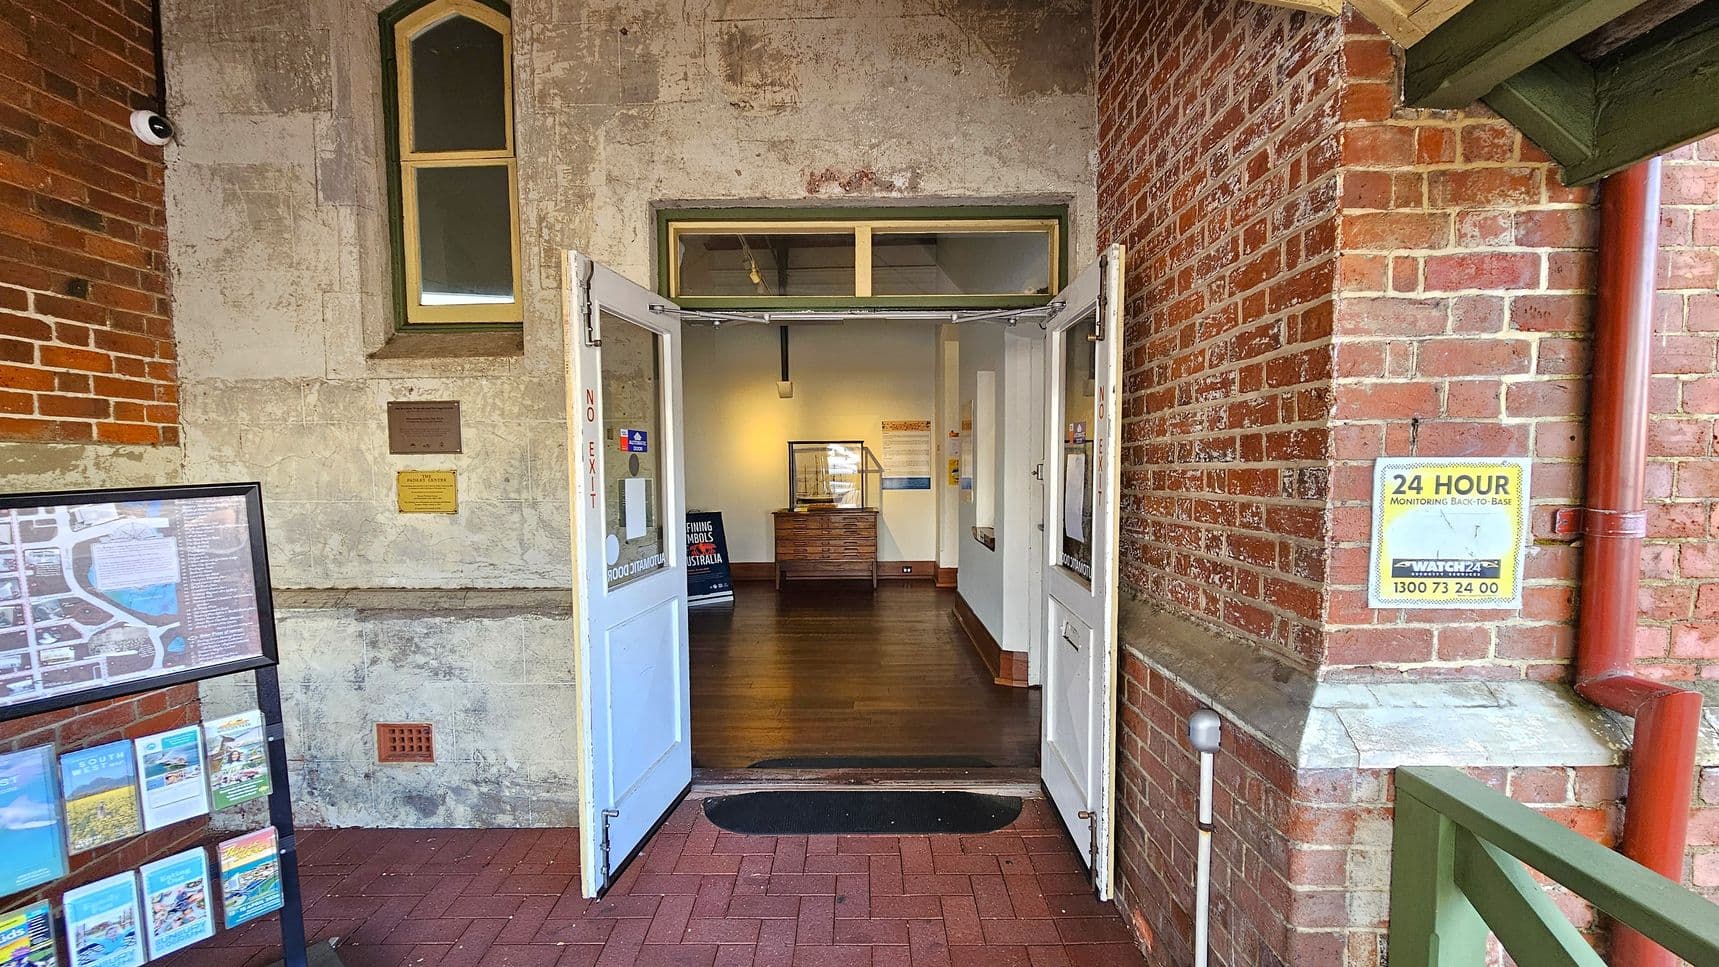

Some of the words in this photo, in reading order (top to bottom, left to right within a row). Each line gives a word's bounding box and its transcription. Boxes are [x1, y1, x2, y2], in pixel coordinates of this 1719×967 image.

[586, 388, 595, 422] NO
[1099, 385, 1105, 420] NO
[589, 442, 597, 509] EXIT
[1391, 473, 1424, 495] 24
[1434, 474, 1511, 496] HOUR
[686, 520, 713, 533] FINING
[687, 532, 714, 544] MBOLS
[687, 552, 723, 567] USTRALIA
[1393, 581, 1427, 594] 1300
[1432, 581, 1449, 594] 73
[1455, 582, 1474, 594] 24
[1479, 582, 1499, 594] 00
[79, 751, 125, 768] SOUTH
